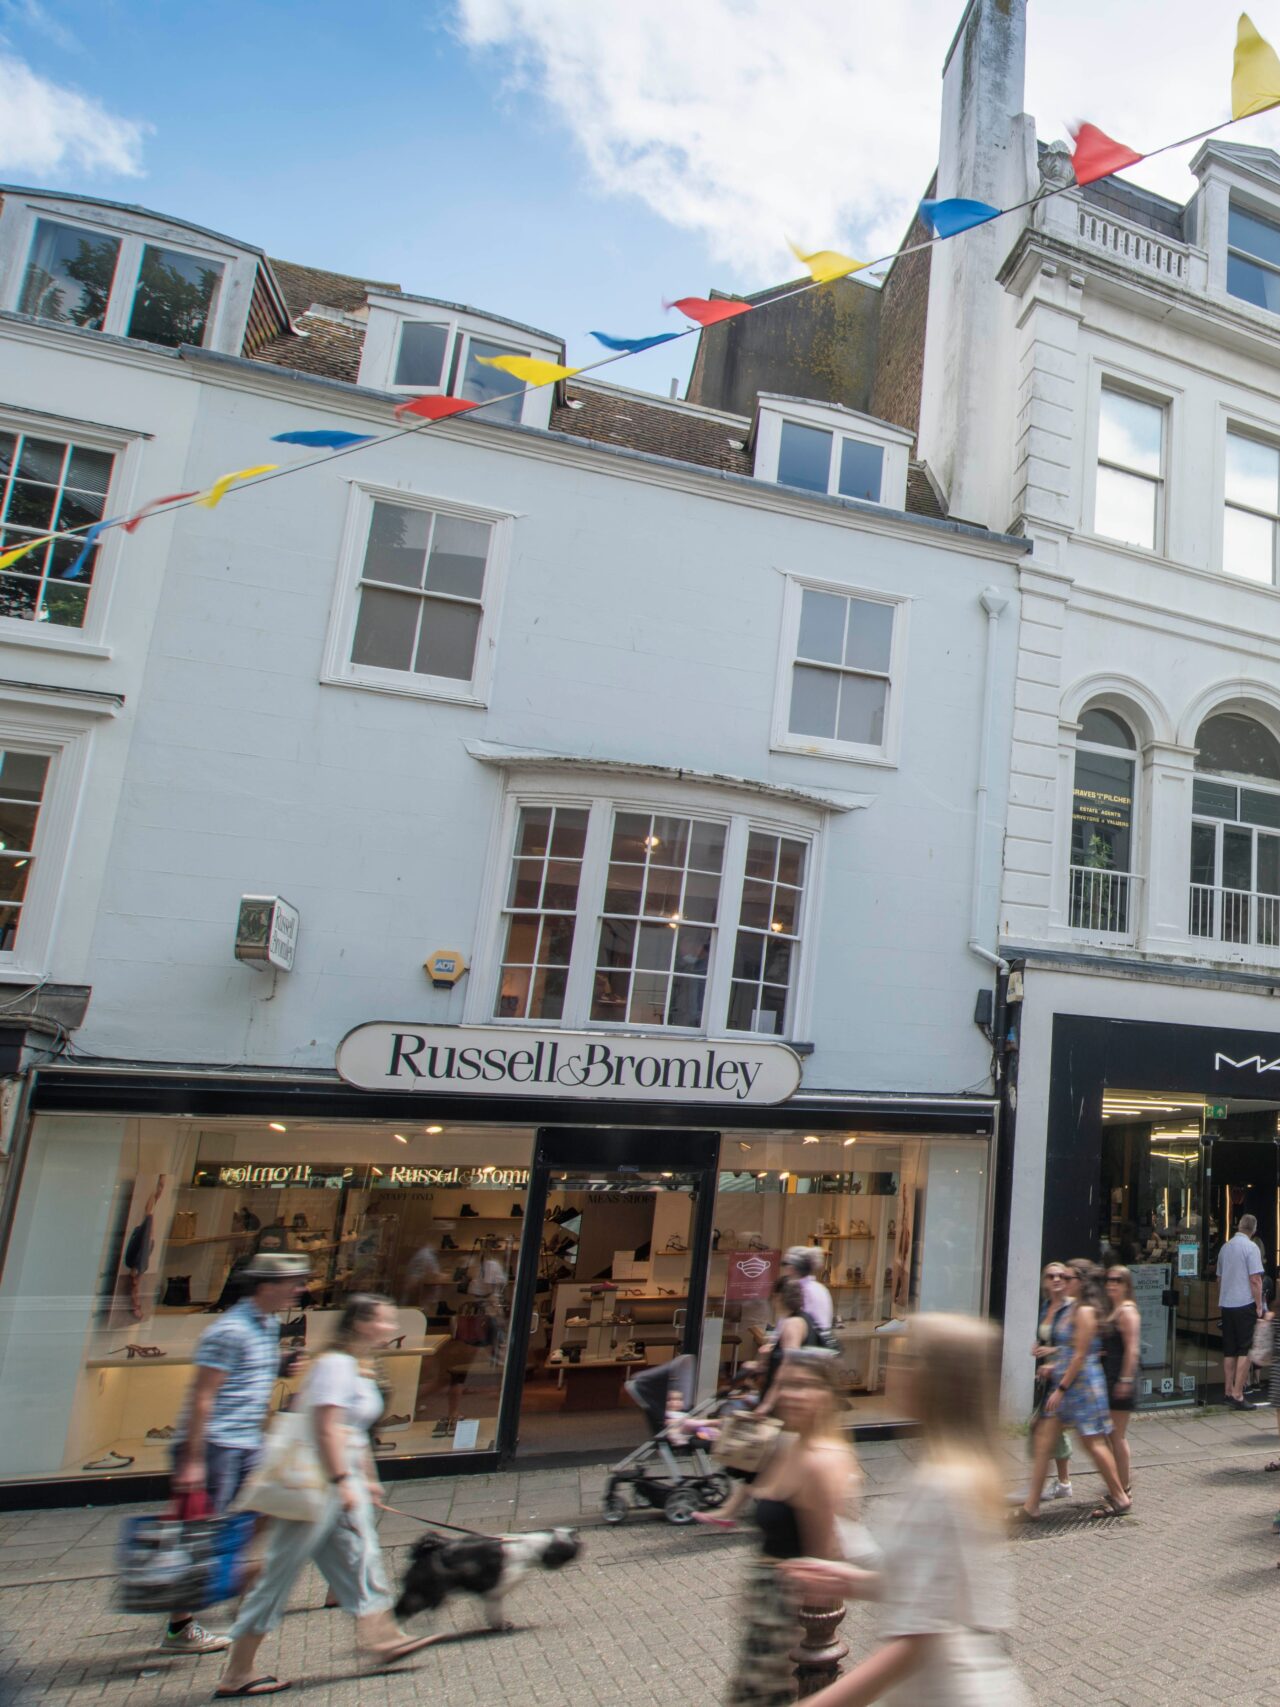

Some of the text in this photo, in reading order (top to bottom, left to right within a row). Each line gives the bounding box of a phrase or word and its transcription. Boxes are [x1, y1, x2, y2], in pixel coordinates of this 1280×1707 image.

[1079, 806, 1121, 818] ESTATE AGENTS
[1106, 818, 1129, 828] VALUERS
[435, 960, 456, 972] ADT
